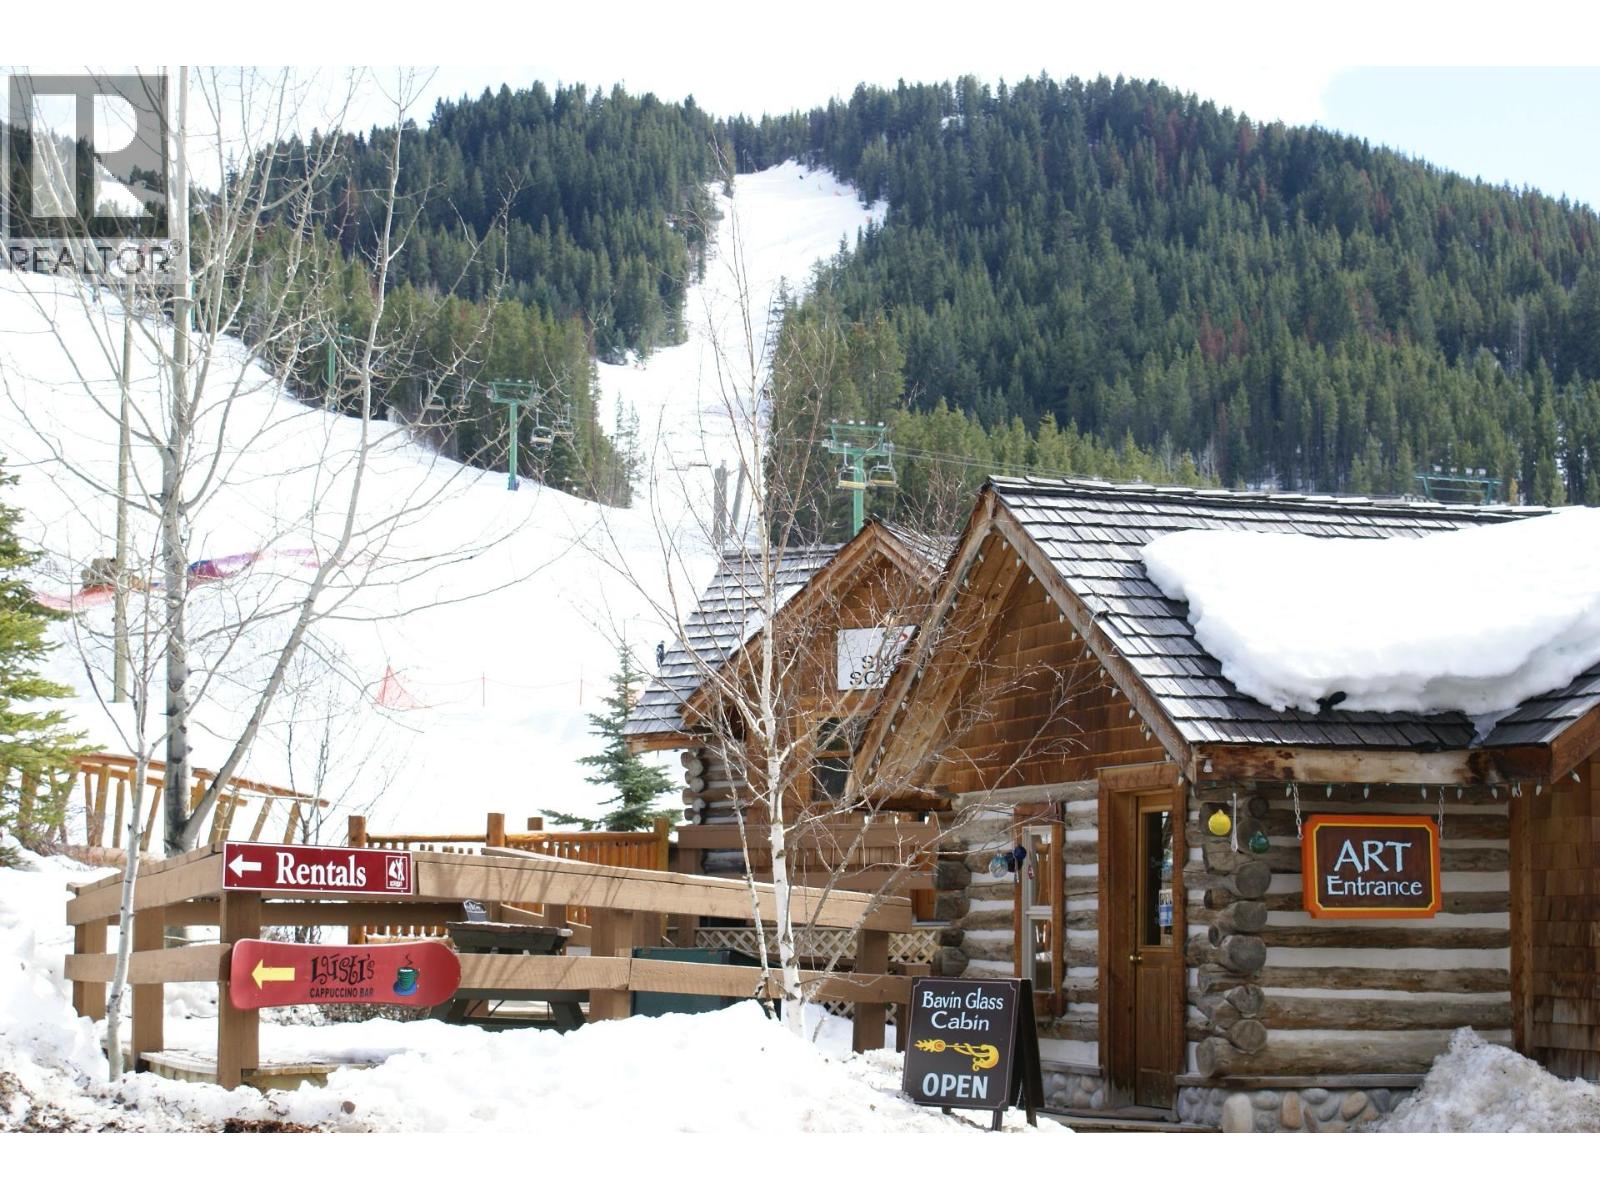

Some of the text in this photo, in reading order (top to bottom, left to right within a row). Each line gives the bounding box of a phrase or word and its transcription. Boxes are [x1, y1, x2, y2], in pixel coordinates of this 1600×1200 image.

[1333, 839, 1412, 873] ART
[276, 852, 366, 887] Rentals
[1326, 875, 1423, 896] Entrance
[309, 987, 375, 998] CAPPUCCINO BAR
[921, 987, 1004, 1010] Bavin Glass
[931, 1010, 990, 1031] Cabin
[922, 1072, 989, 1099] OPEN
